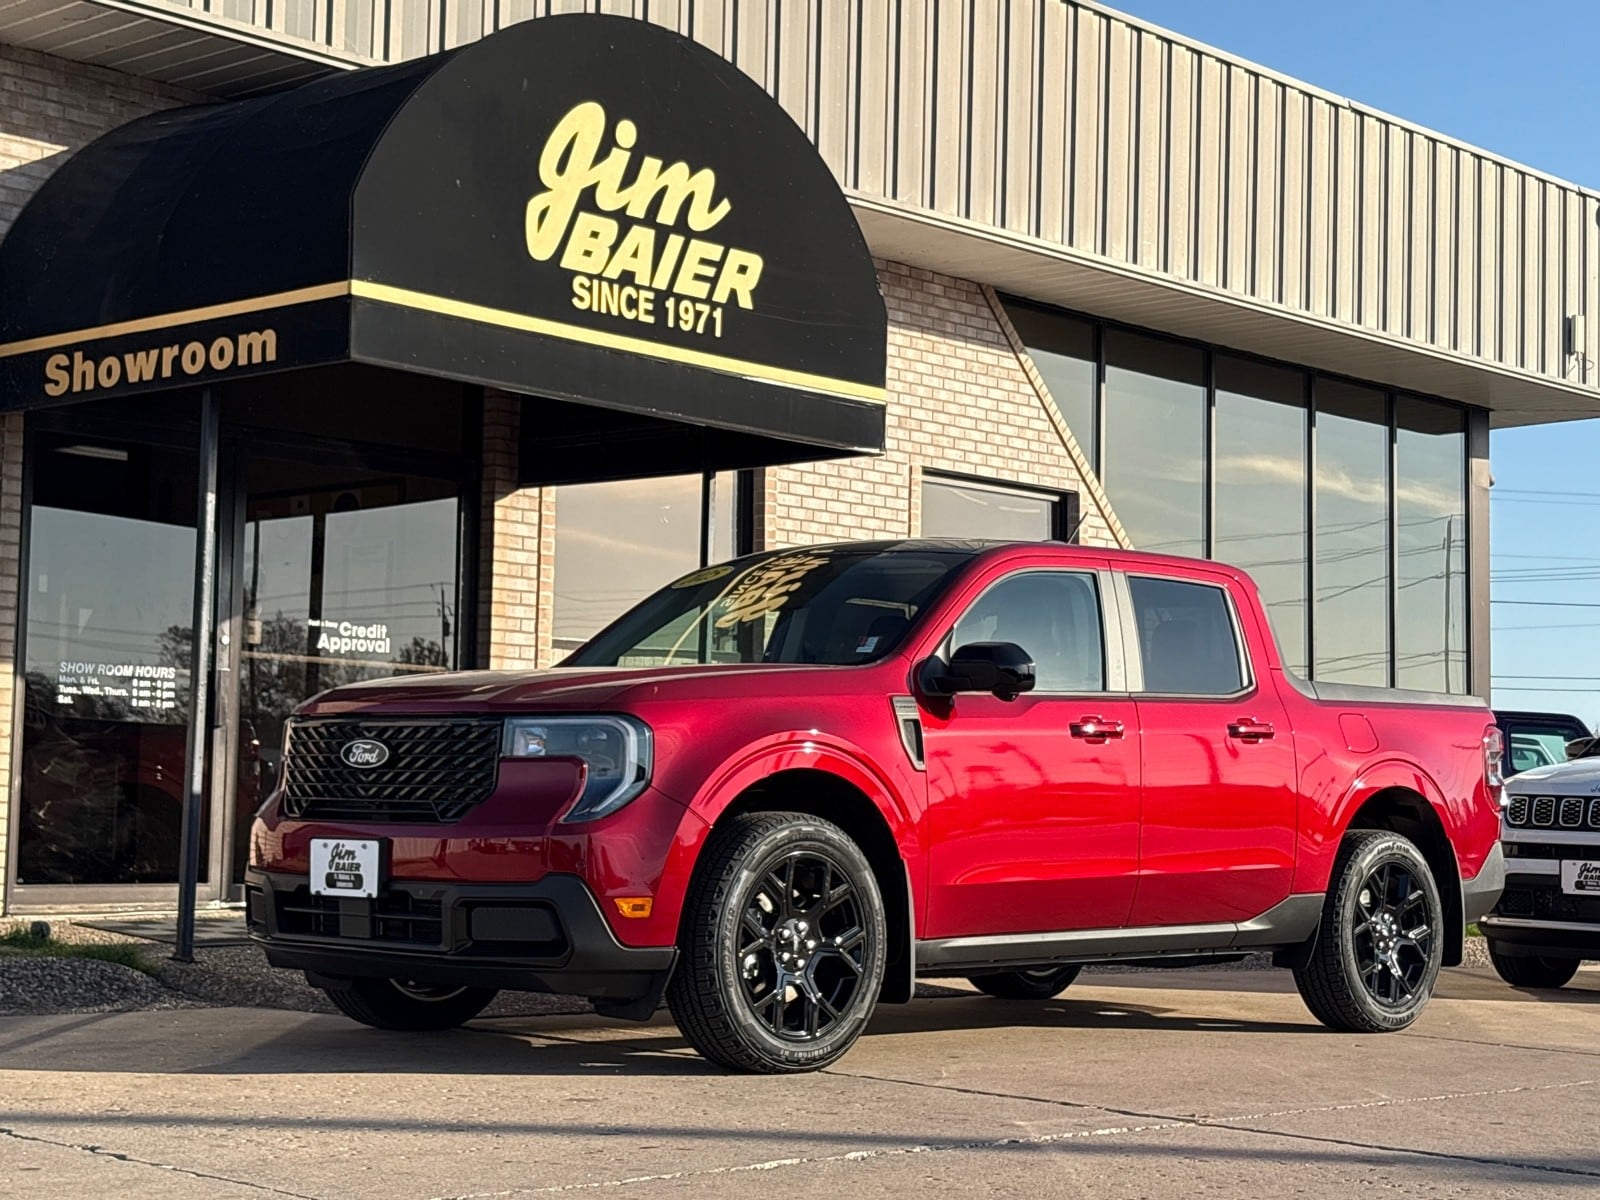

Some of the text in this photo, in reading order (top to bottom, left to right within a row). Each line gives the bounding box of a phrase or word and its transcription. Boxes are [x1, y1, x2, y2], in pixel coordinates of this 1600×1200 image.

[525, 102, 732, 261] Jim
[560, 211, 763, 310] BAIER
[571, 275, 723, 338] SINCE 1971
[44, 328, 277, 397] Showroom
[339, 621, 387, 639] Credit
[317, 632, 390, 654] Approval
[60, 661, 176, 679] SHOW ROOM HOURS
[349, 743, 380, 764] Ford
[328, 842, 357, 871] Jim
[334, 862, 362, 872] BAIER
